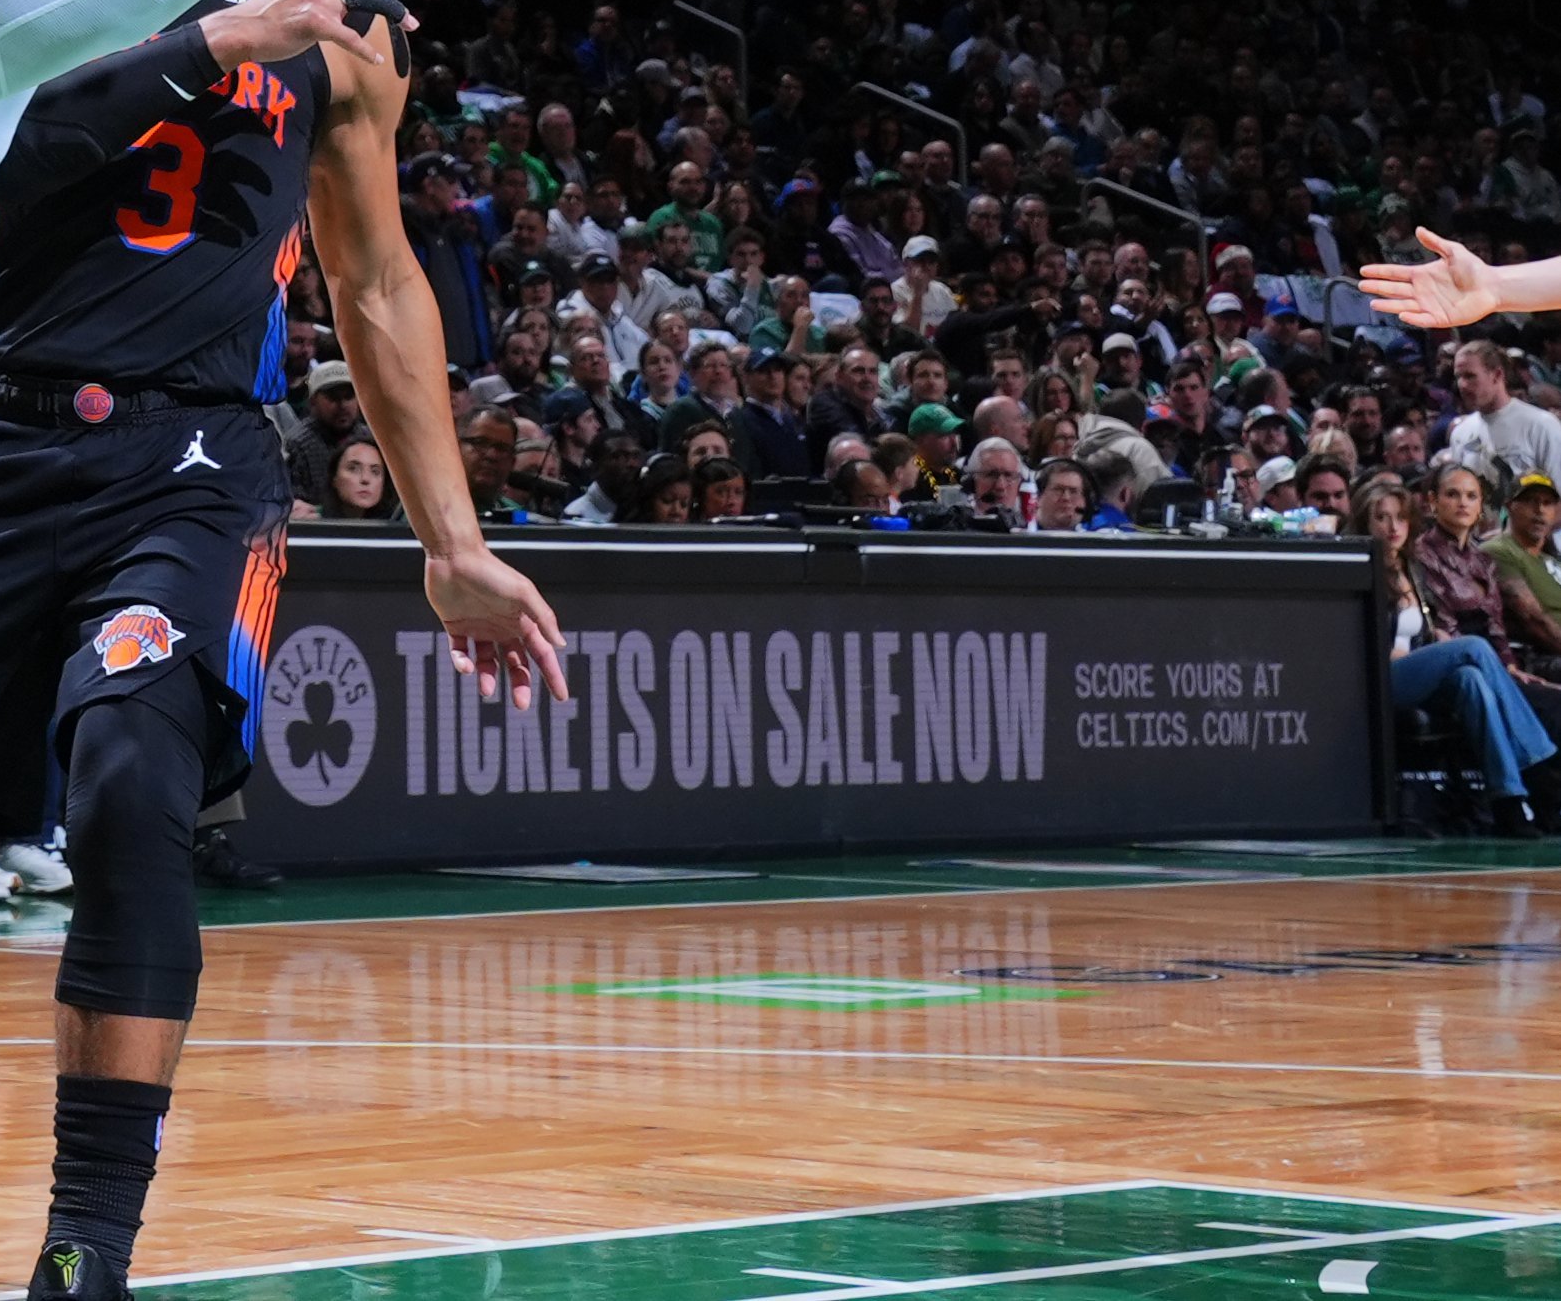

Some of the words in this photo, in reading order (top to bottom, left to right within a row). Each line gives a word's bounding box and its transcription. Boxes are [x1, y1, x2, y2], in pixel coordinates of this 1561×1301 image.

[114, 118, 207, 256] 3
[270, 636, 368, 707] CELTICS
[1074, 662, 1154, 700] SCORE
[1165, 662, 1242, 699] YOURS
[1252, 662, 1283, 697] AT
[669, 630, 753, 790] ON
[765, 630, 904, 788] SALE
[911, 630, 1047, 784] NOW
[1076, 710, 1309, 750] CELTICS.COM/TIX
